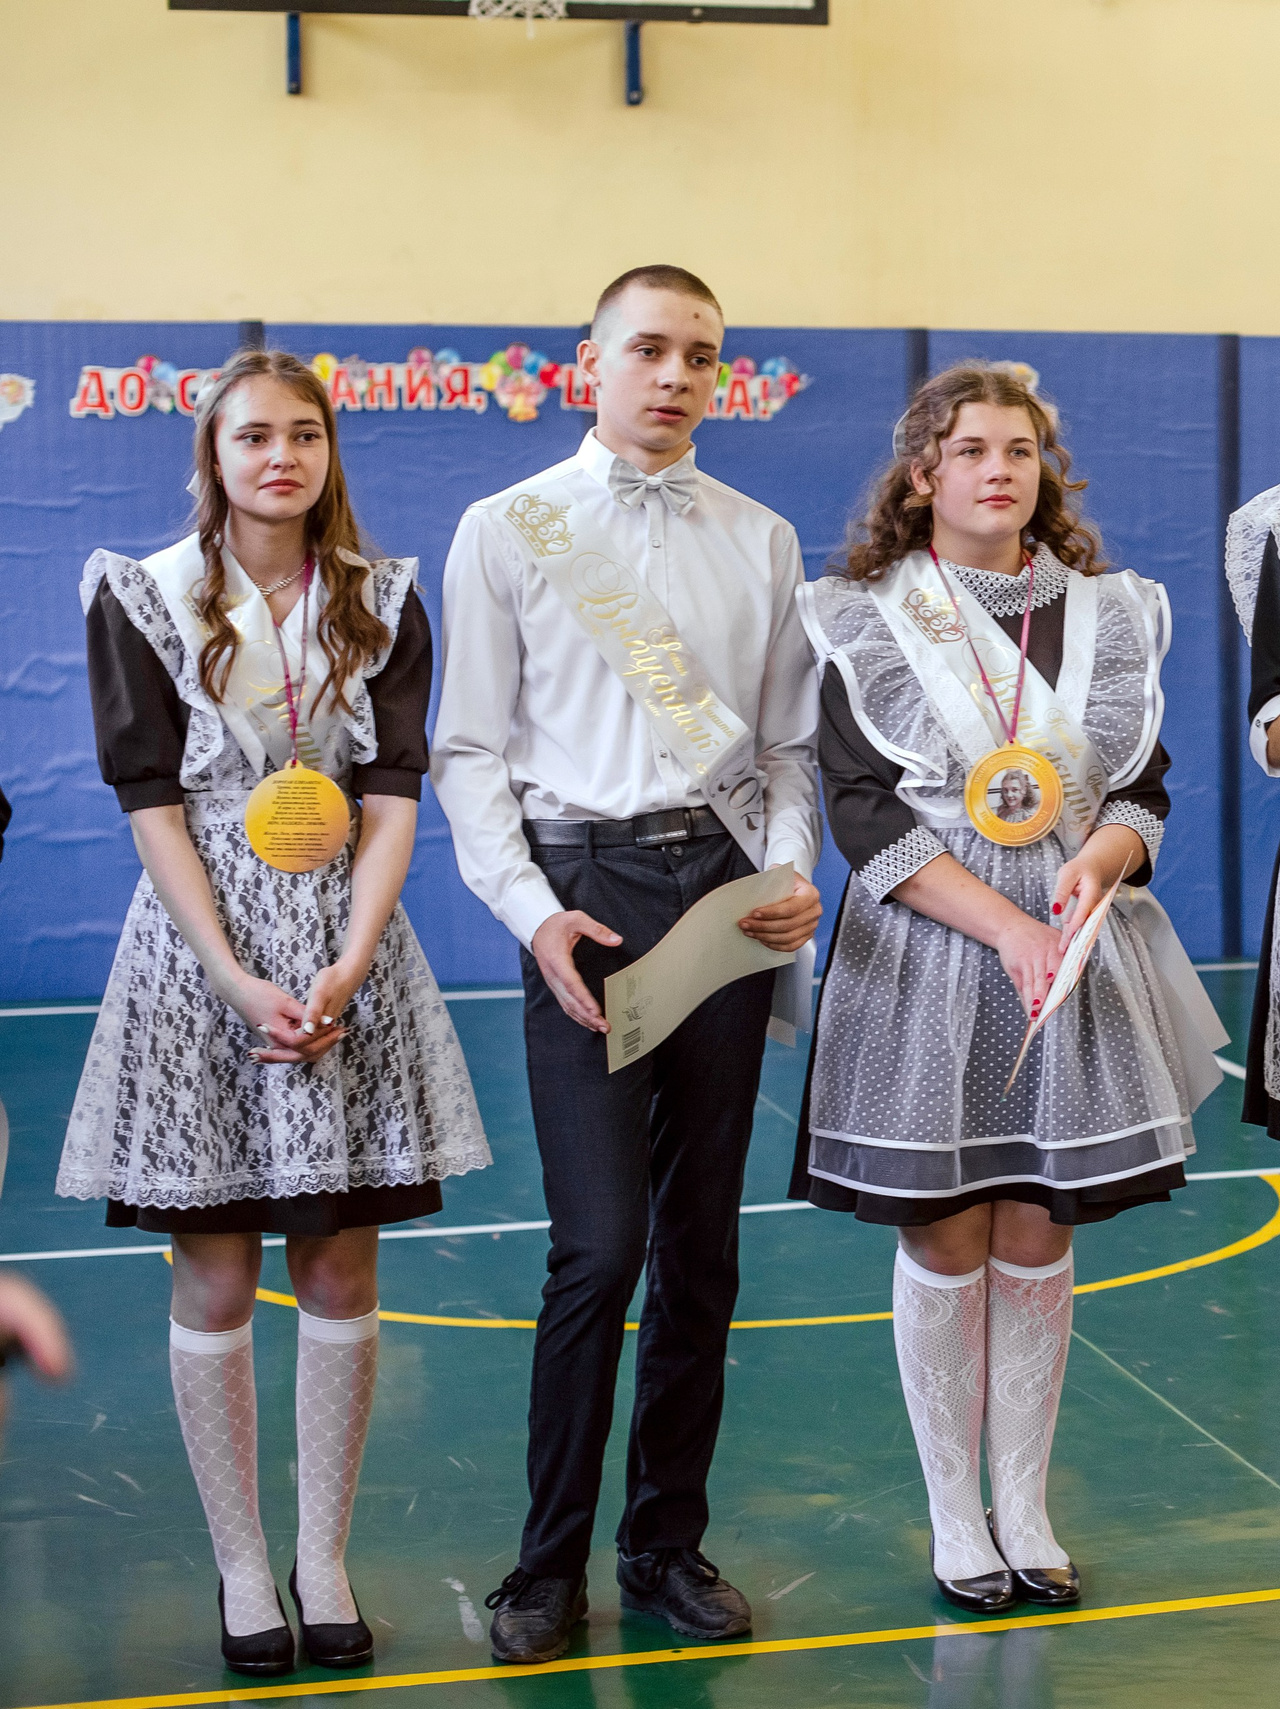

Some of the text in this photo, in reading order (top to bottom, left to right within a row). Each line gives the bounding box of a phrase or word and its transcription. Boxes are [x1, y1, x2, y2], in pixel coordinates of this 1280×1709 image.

[73, 368, 147, 416] ДО
[176, 366, 488, 412] САНИЯ,
[569, 551, 721, 754] Выпускник
